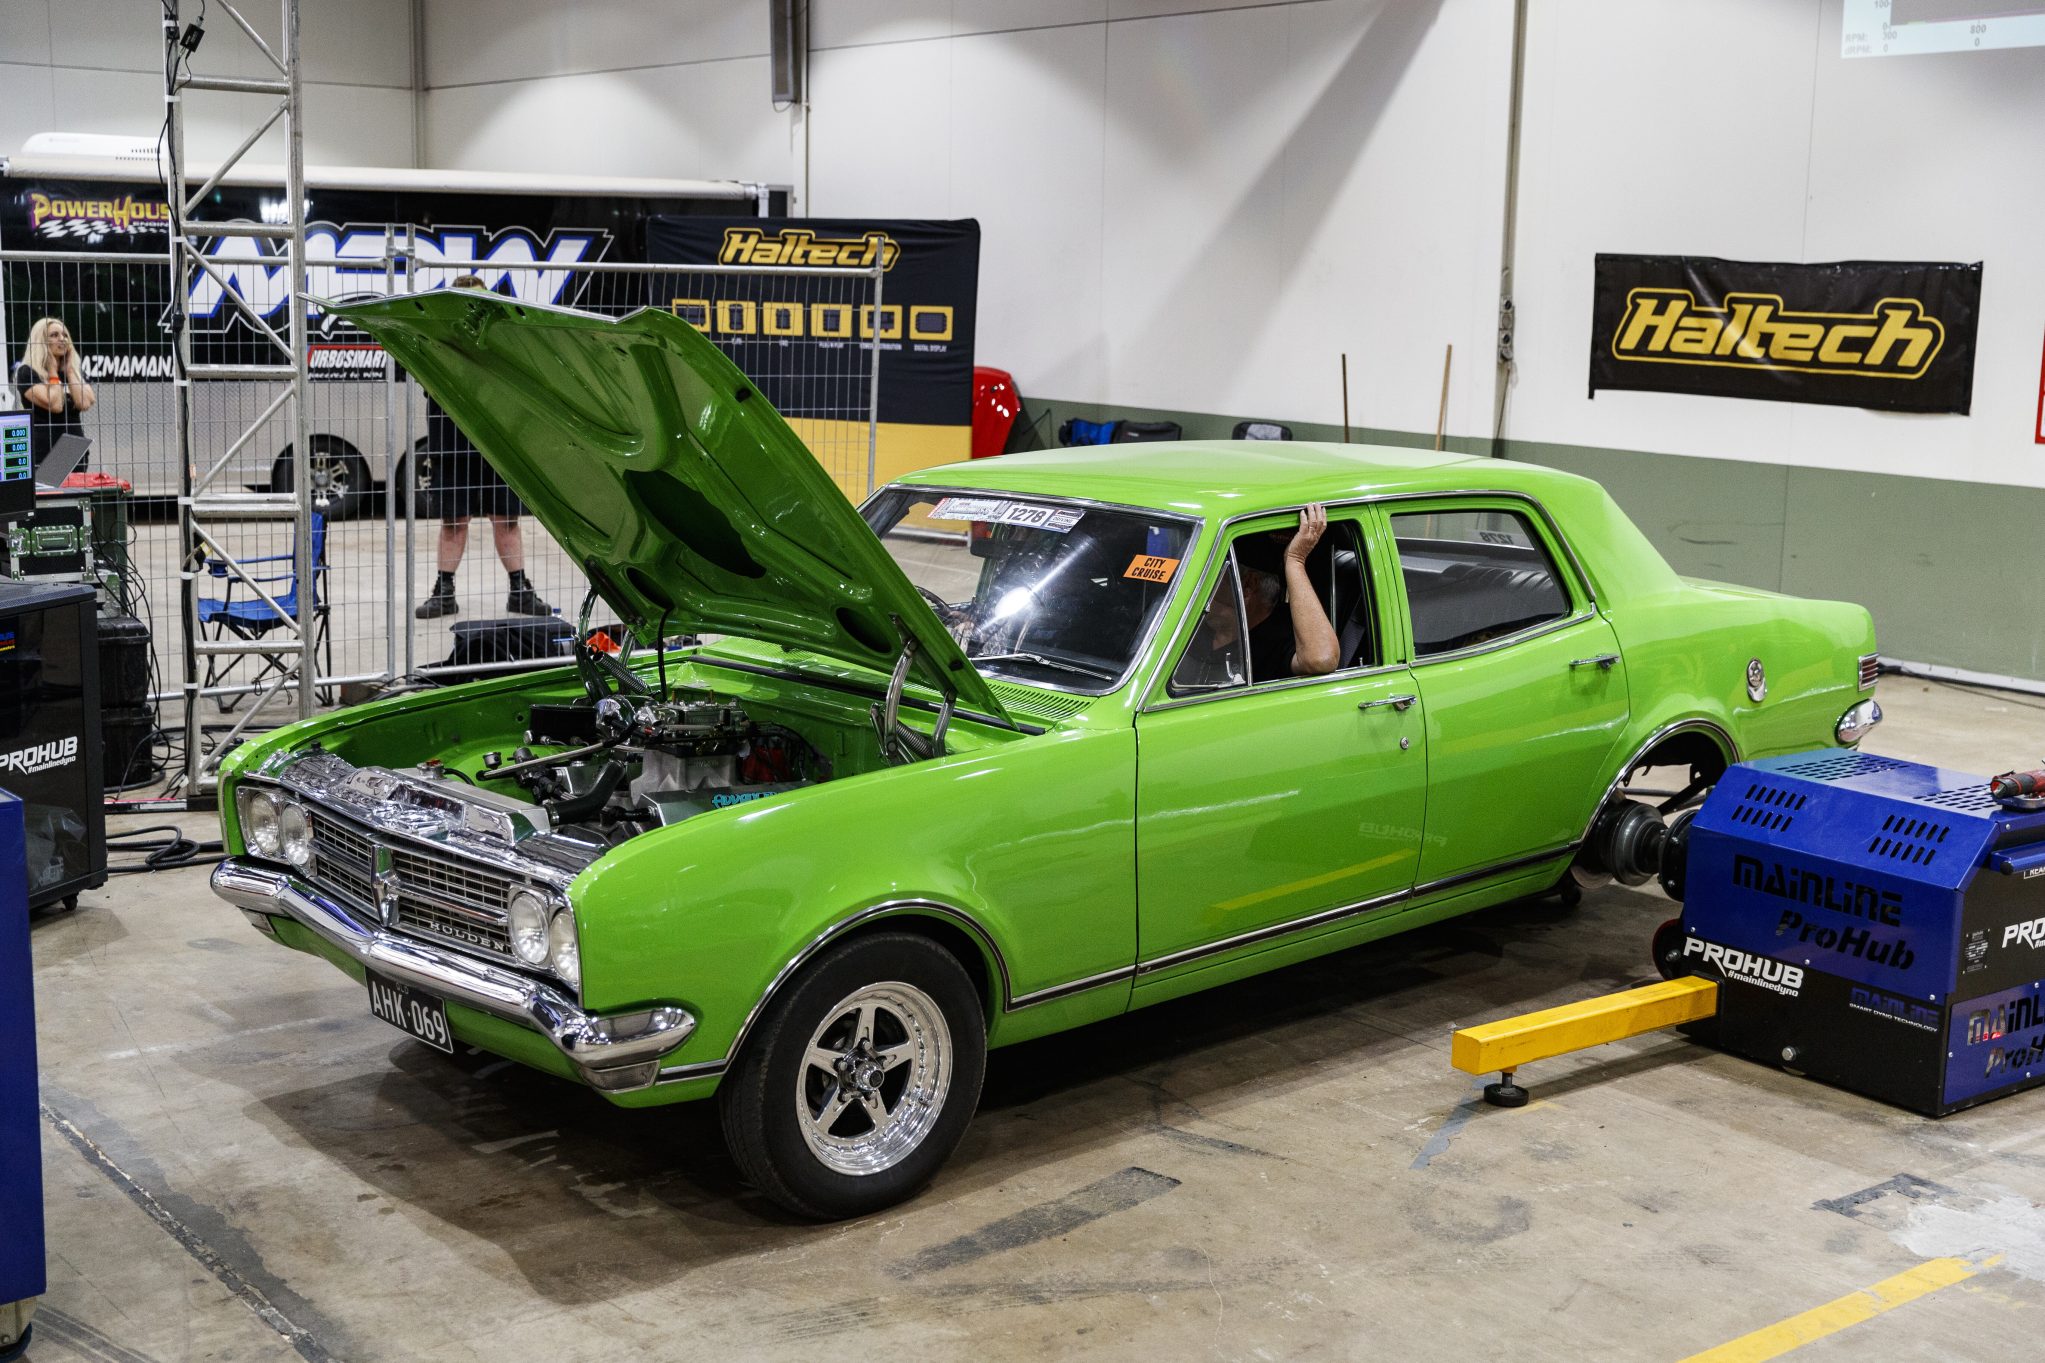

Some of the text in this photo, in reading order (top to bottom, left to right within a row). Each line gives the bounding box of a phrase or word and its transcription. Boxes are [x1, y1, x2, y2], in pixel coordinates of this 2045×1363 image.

[31, 193, 170, 228] POWERHOUS
[722, 233, 896, 266] Haltech
[1619, 298, 1934, 368] Haltech
[1007, 508, 1046, 523] 1278
[1131, 567, 1166, 580] CRUISE
[1144, 557, 1166, 568] CITY
[0, 736, 78, 775] PROHUB
[28, 756, 76, 773] #mainlinedyno
[428, 920, 505, 951] HOLDEN
[1683, 936, 1804, 989] PROHUB
[1728, 969, 1799, 997] #mainlinedyno
[1849, 1002, 1938, 1032] SMART DYNO TECHNOLOGY
